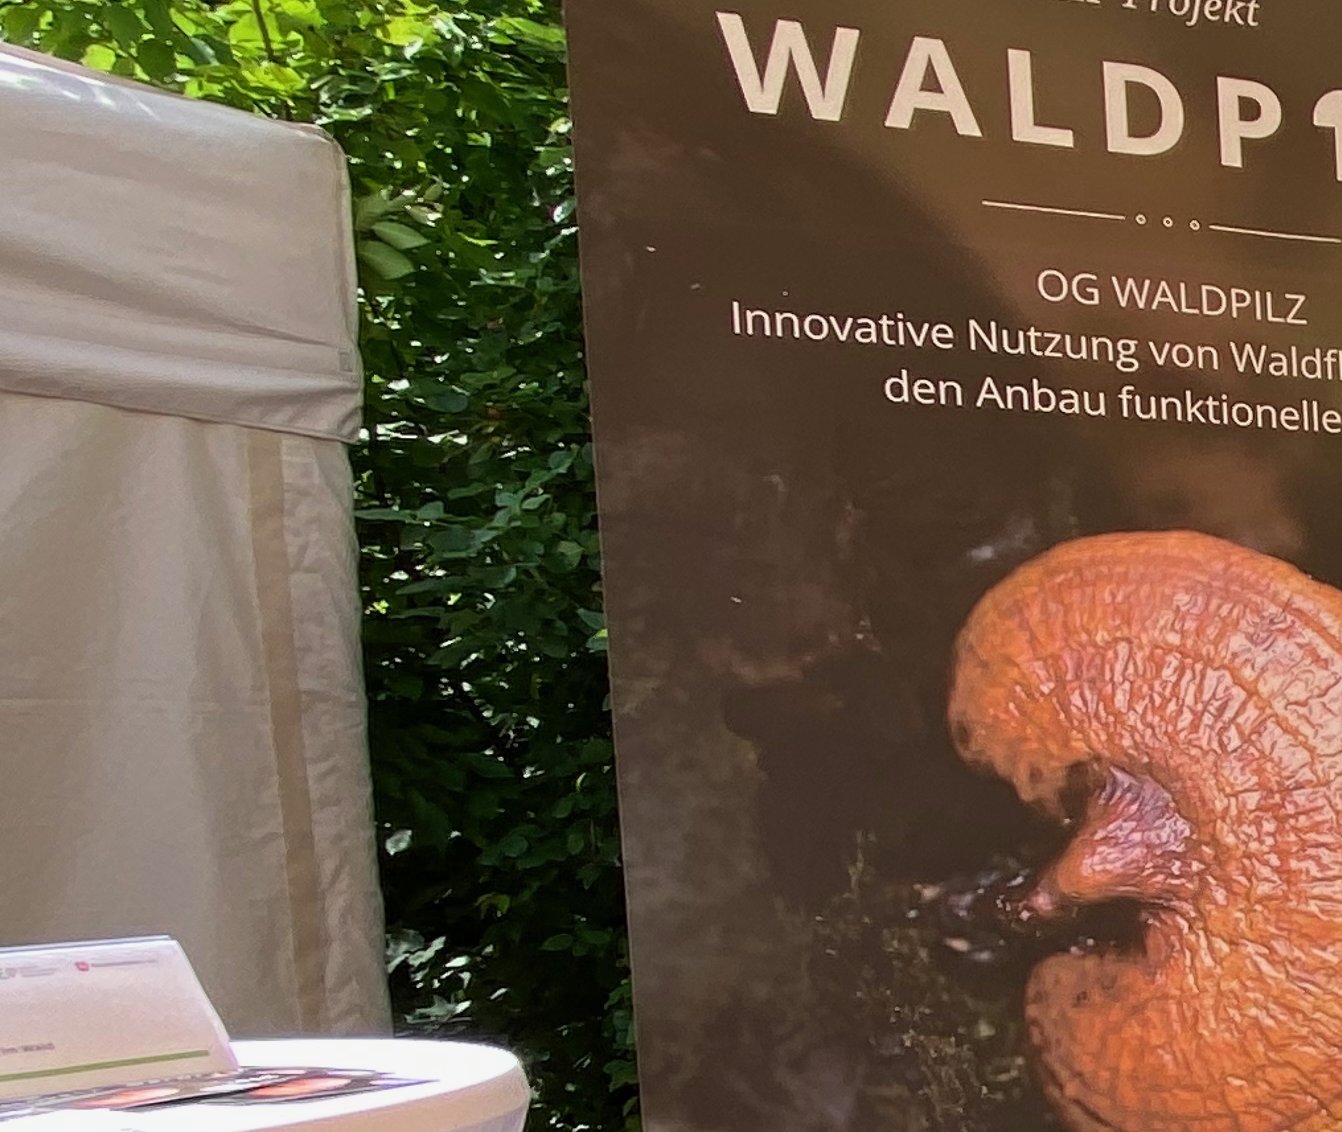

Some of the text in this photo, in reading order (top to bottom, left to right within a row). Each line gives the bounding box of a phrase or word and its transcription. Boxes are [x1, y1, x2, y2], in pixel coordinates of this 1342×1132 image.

[1037, 268, 1309, 326] OG WALDPILZ
[731, 300, 954, 350] Innovative
[968, 319, 1140, 373] Nutzung
[1148, 340, 1219, 371] von
[884, 369, 963, 406] den
[976, 375, 1106, 417] Anbau
